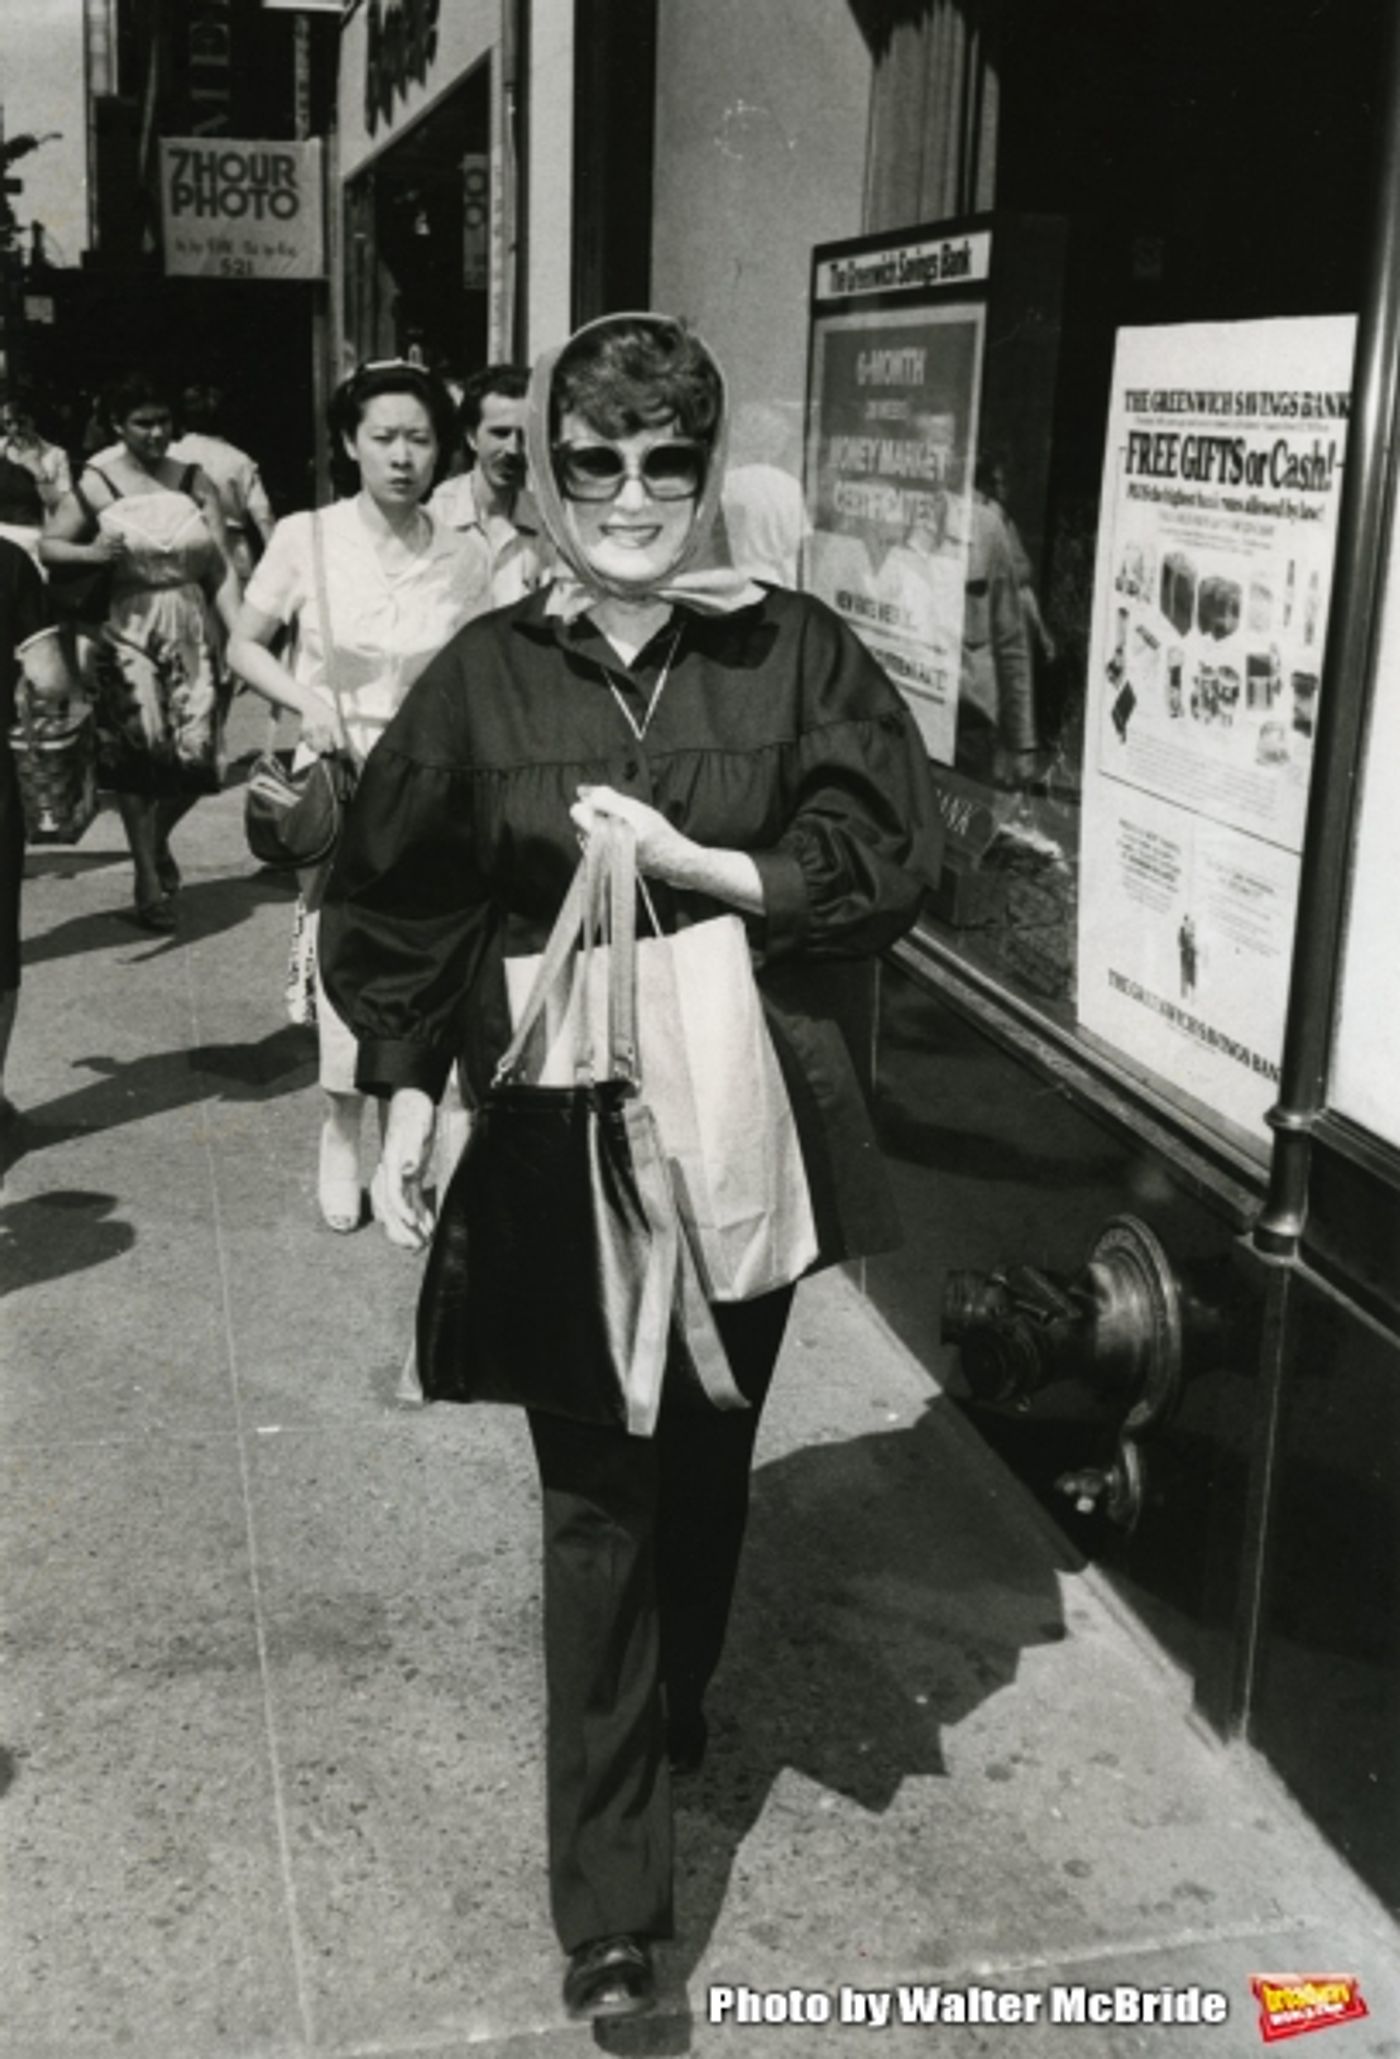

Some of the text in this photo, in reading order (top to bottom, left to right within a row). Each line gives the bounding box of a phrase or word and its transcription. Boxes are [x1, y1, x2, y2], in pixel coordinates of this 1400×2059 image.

[172, 182, 301, 221] PHOTO
[941, 240, 972, 279] Bank
[1126, 390, 1350, 419] THE GREENWICH SAVINGS BANK
[1125, 430, 1336, 492] FREE GIFTS or Cash!
[1252, 1052, 1284, 1086] BAN
